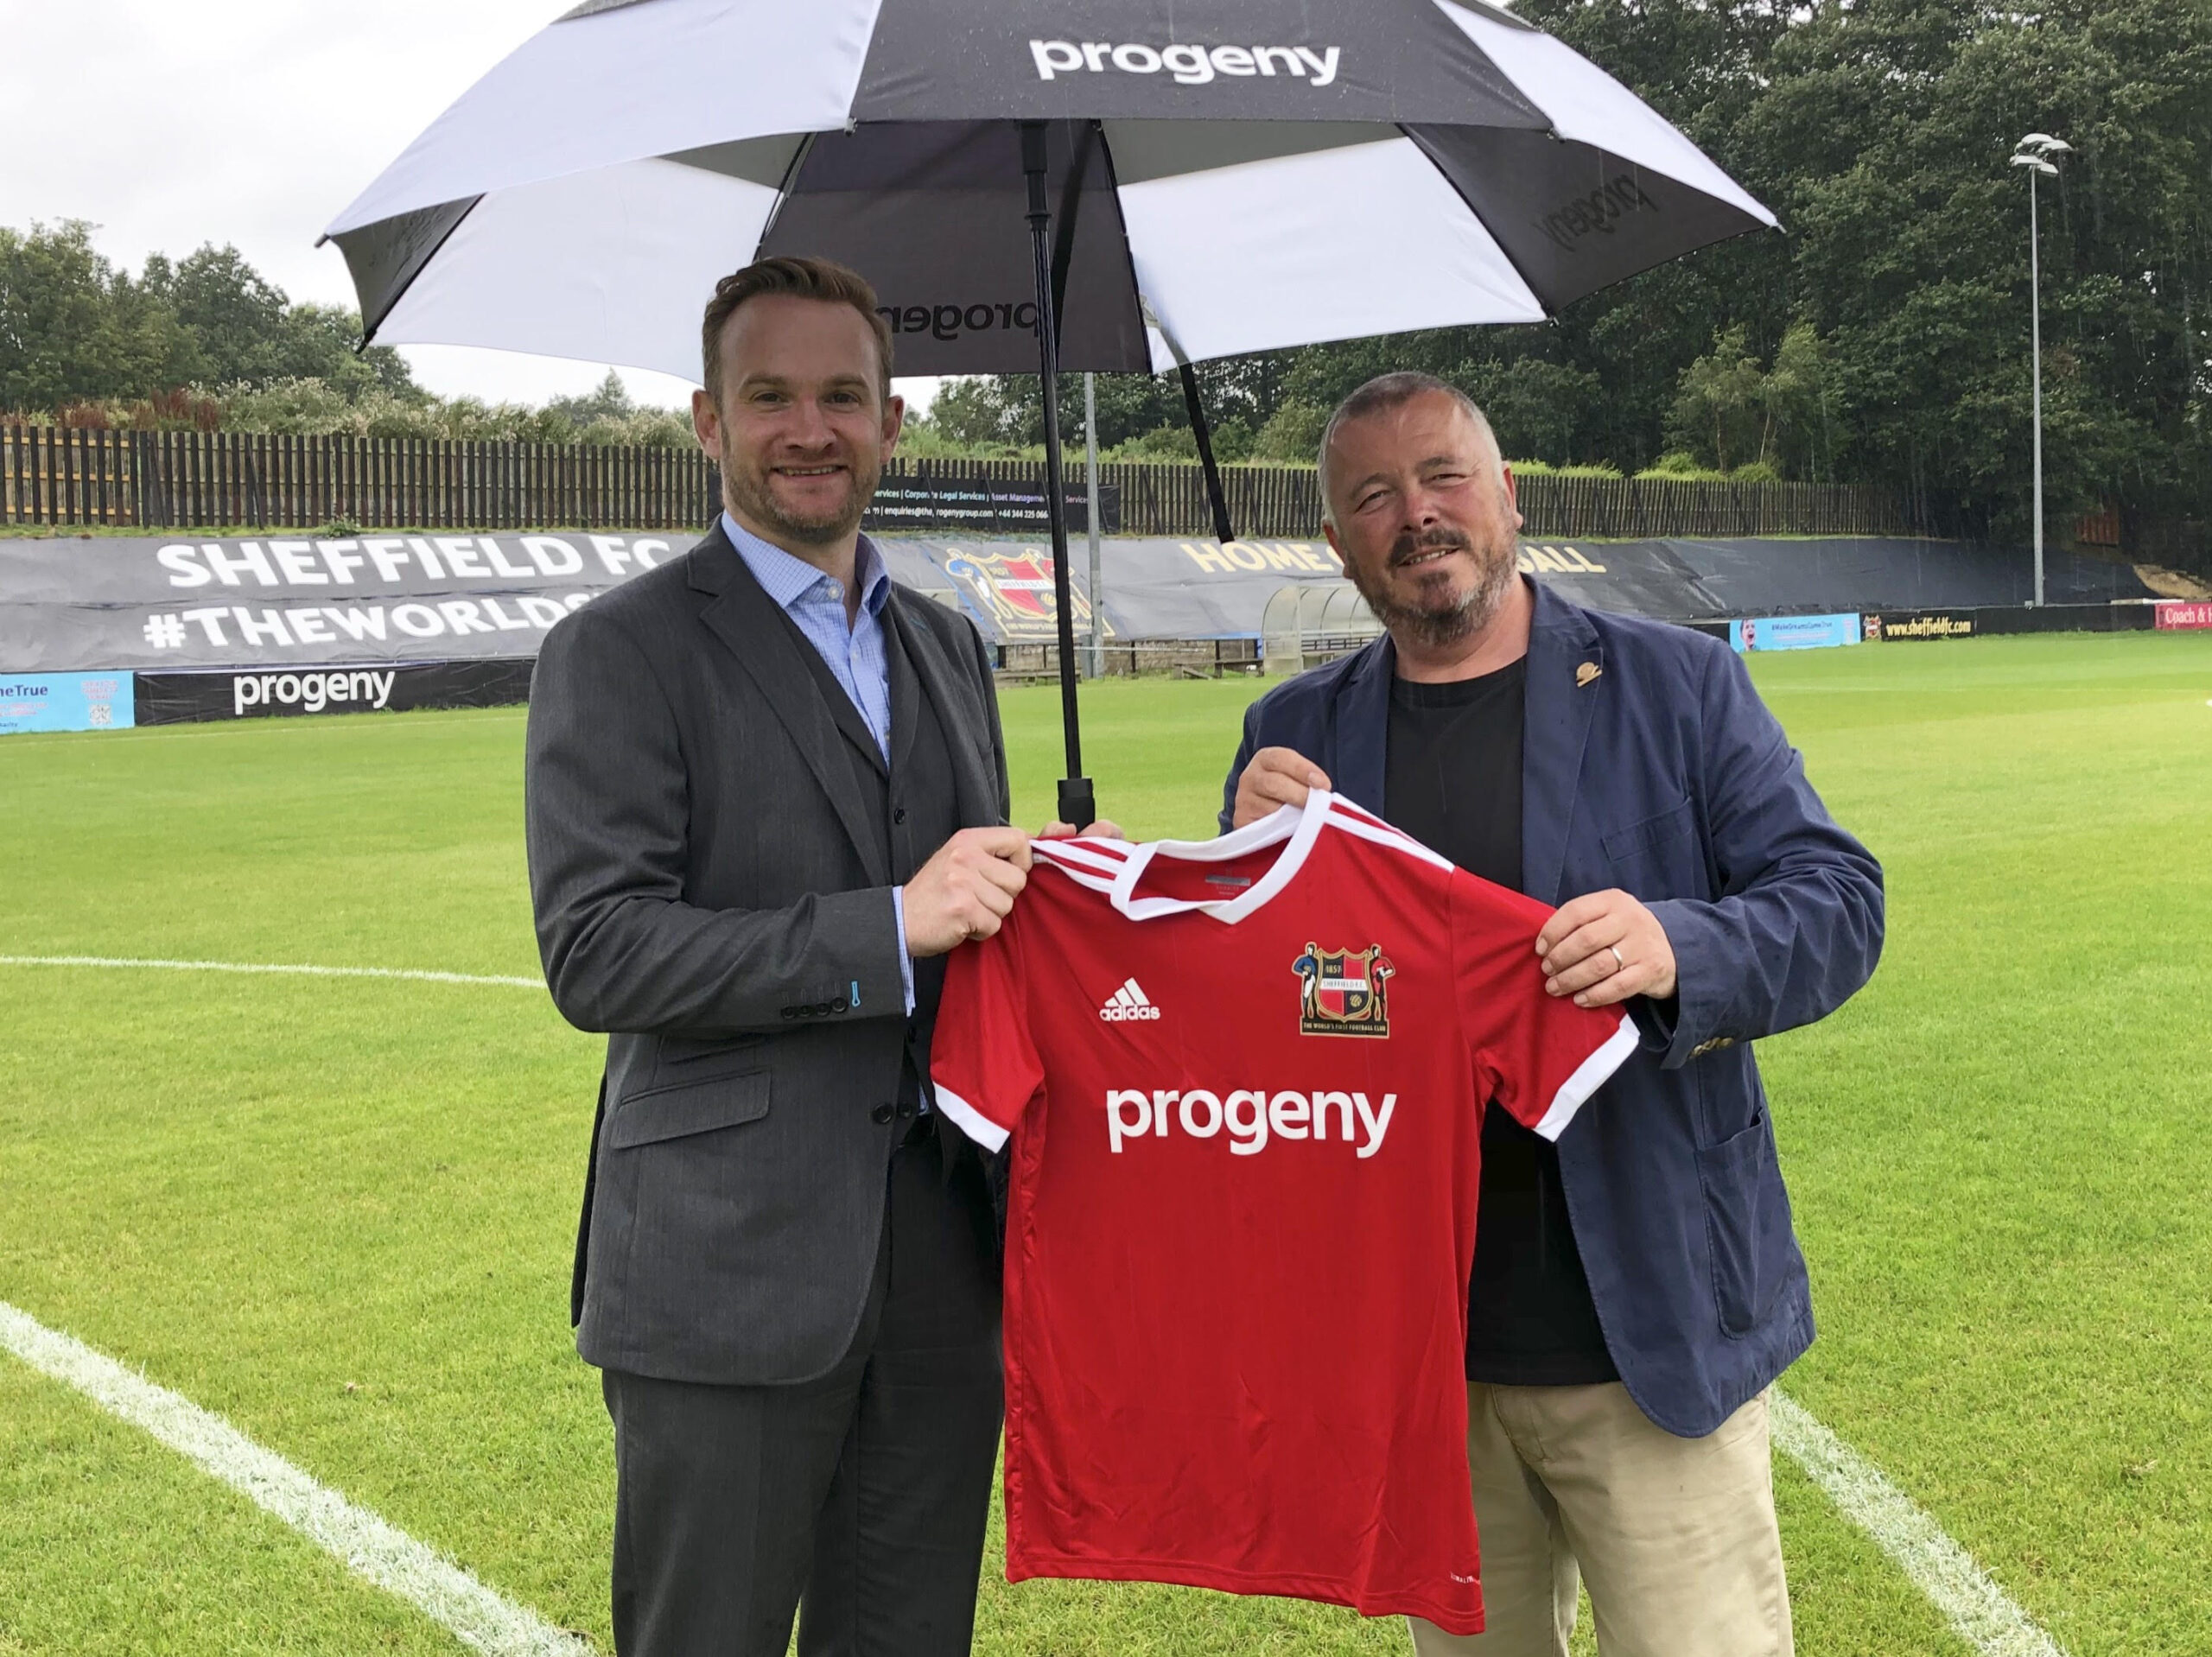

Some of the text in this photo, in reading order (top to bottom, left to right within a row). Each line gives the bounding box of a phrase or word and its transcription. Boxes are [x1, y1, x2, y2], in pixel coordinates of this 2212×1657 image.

[1029, 39, 1340, 86] progeny
[874, 489, 899, 498] ervices
[939, 491, 957, 502] Legal
[958, 491, 985, 500] Services
[1009, 492, 1049, 504] Managemen
[885, 505, 993, 518] enquiries@therogenygroup.com
[156, 536, 670, 587] SHEFFIELD FC
[1179, 541, 1334, 573] HOME
[1885, 616, 1971, 637] www.sheffieldfc.com
[2197, 606, 2205, 623] &
[234, 671, 395, 715] progeny
[1100, 1005, 1160, 1021] adidas
[1106, 1089, 1397, 1159] progeny
